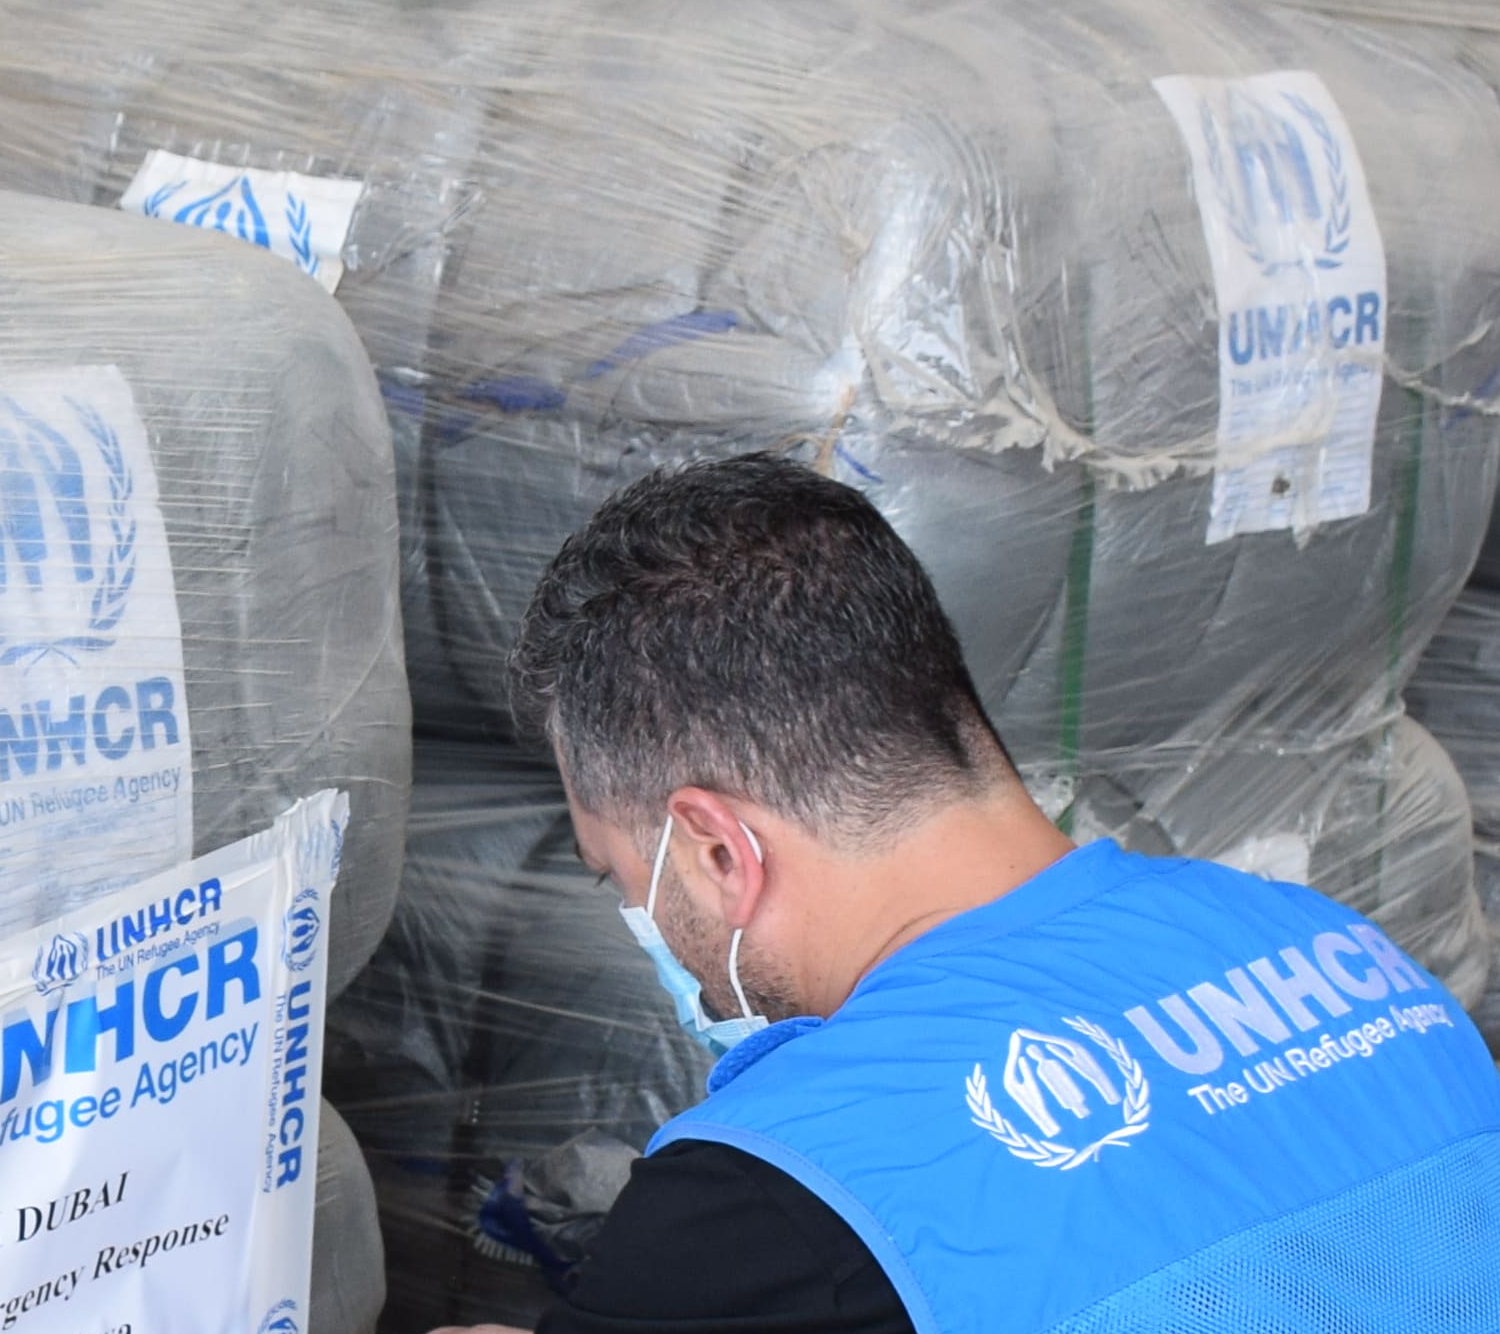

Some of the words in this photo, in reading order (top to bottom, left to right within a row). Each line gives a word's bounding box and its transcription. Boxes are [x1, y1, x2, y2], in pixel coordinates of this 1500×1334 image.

[112, 766, 183, 804] Agency
[96, 876, 222, 962] UNHCR
[1122, 922, 1431, 1075] UNHCR
[129, 1021, 260, 1110] Agency
[275, 979, 312, 1189] UNHCR
[1187, 1080, 1251, 1116] The
[1243, 1056, 1298, 1096] UN
[1284, 1016, 1396, 1078] Refugee
[14, 1170, 132, 1244] DUBAI
[91, 1212, 230, 1282] Response
